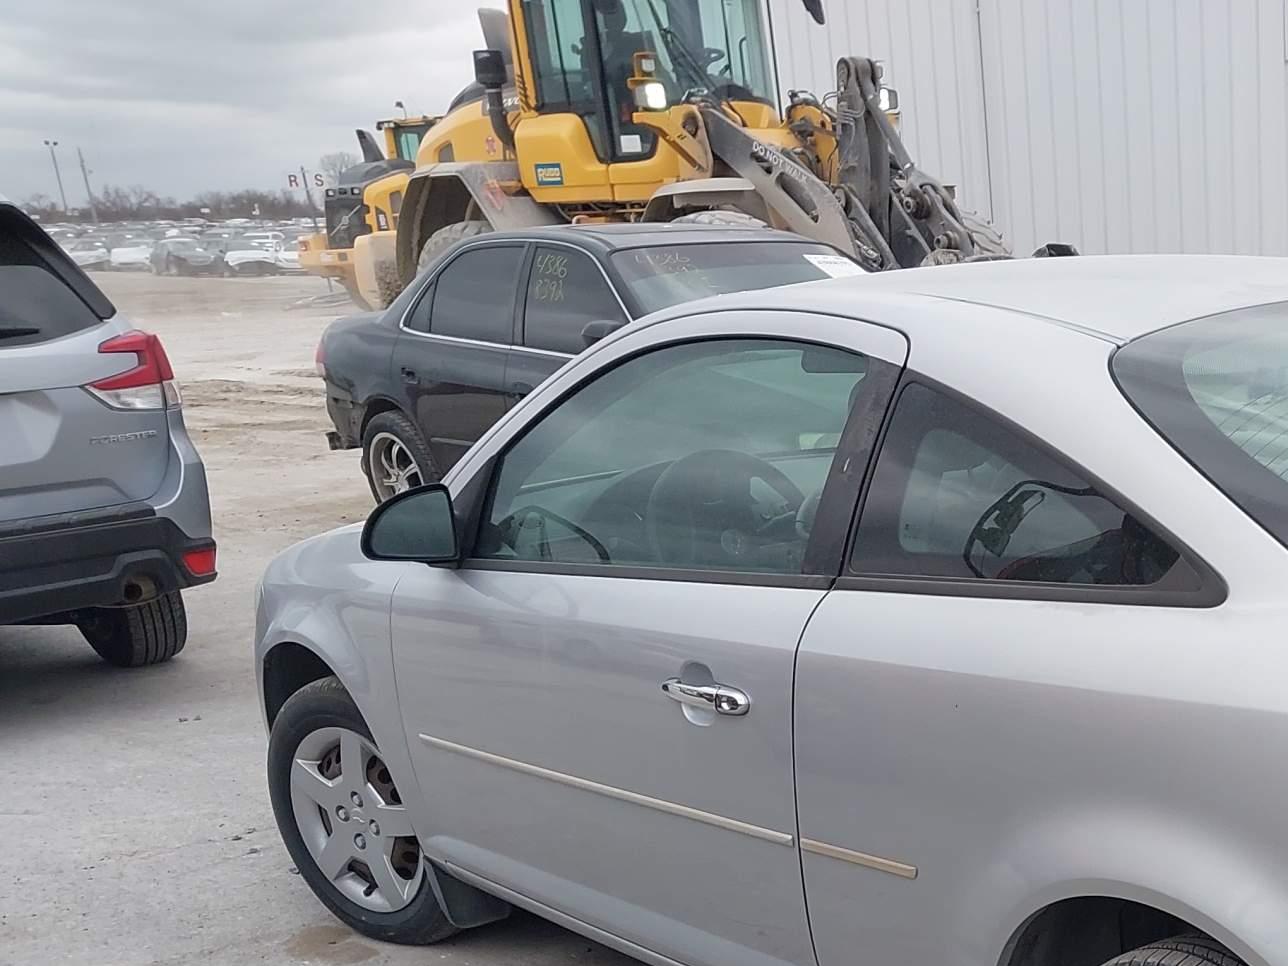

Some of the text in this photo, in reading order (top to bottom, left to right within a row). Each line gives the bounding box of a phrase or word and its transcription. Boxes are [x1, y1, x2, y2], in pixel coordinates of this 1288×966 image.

[752, 141, 765, 156] DO
[765, 148, 783, 168] NOT
[288, 174, 299, 188] R
[314, 173, 325, 187] S
